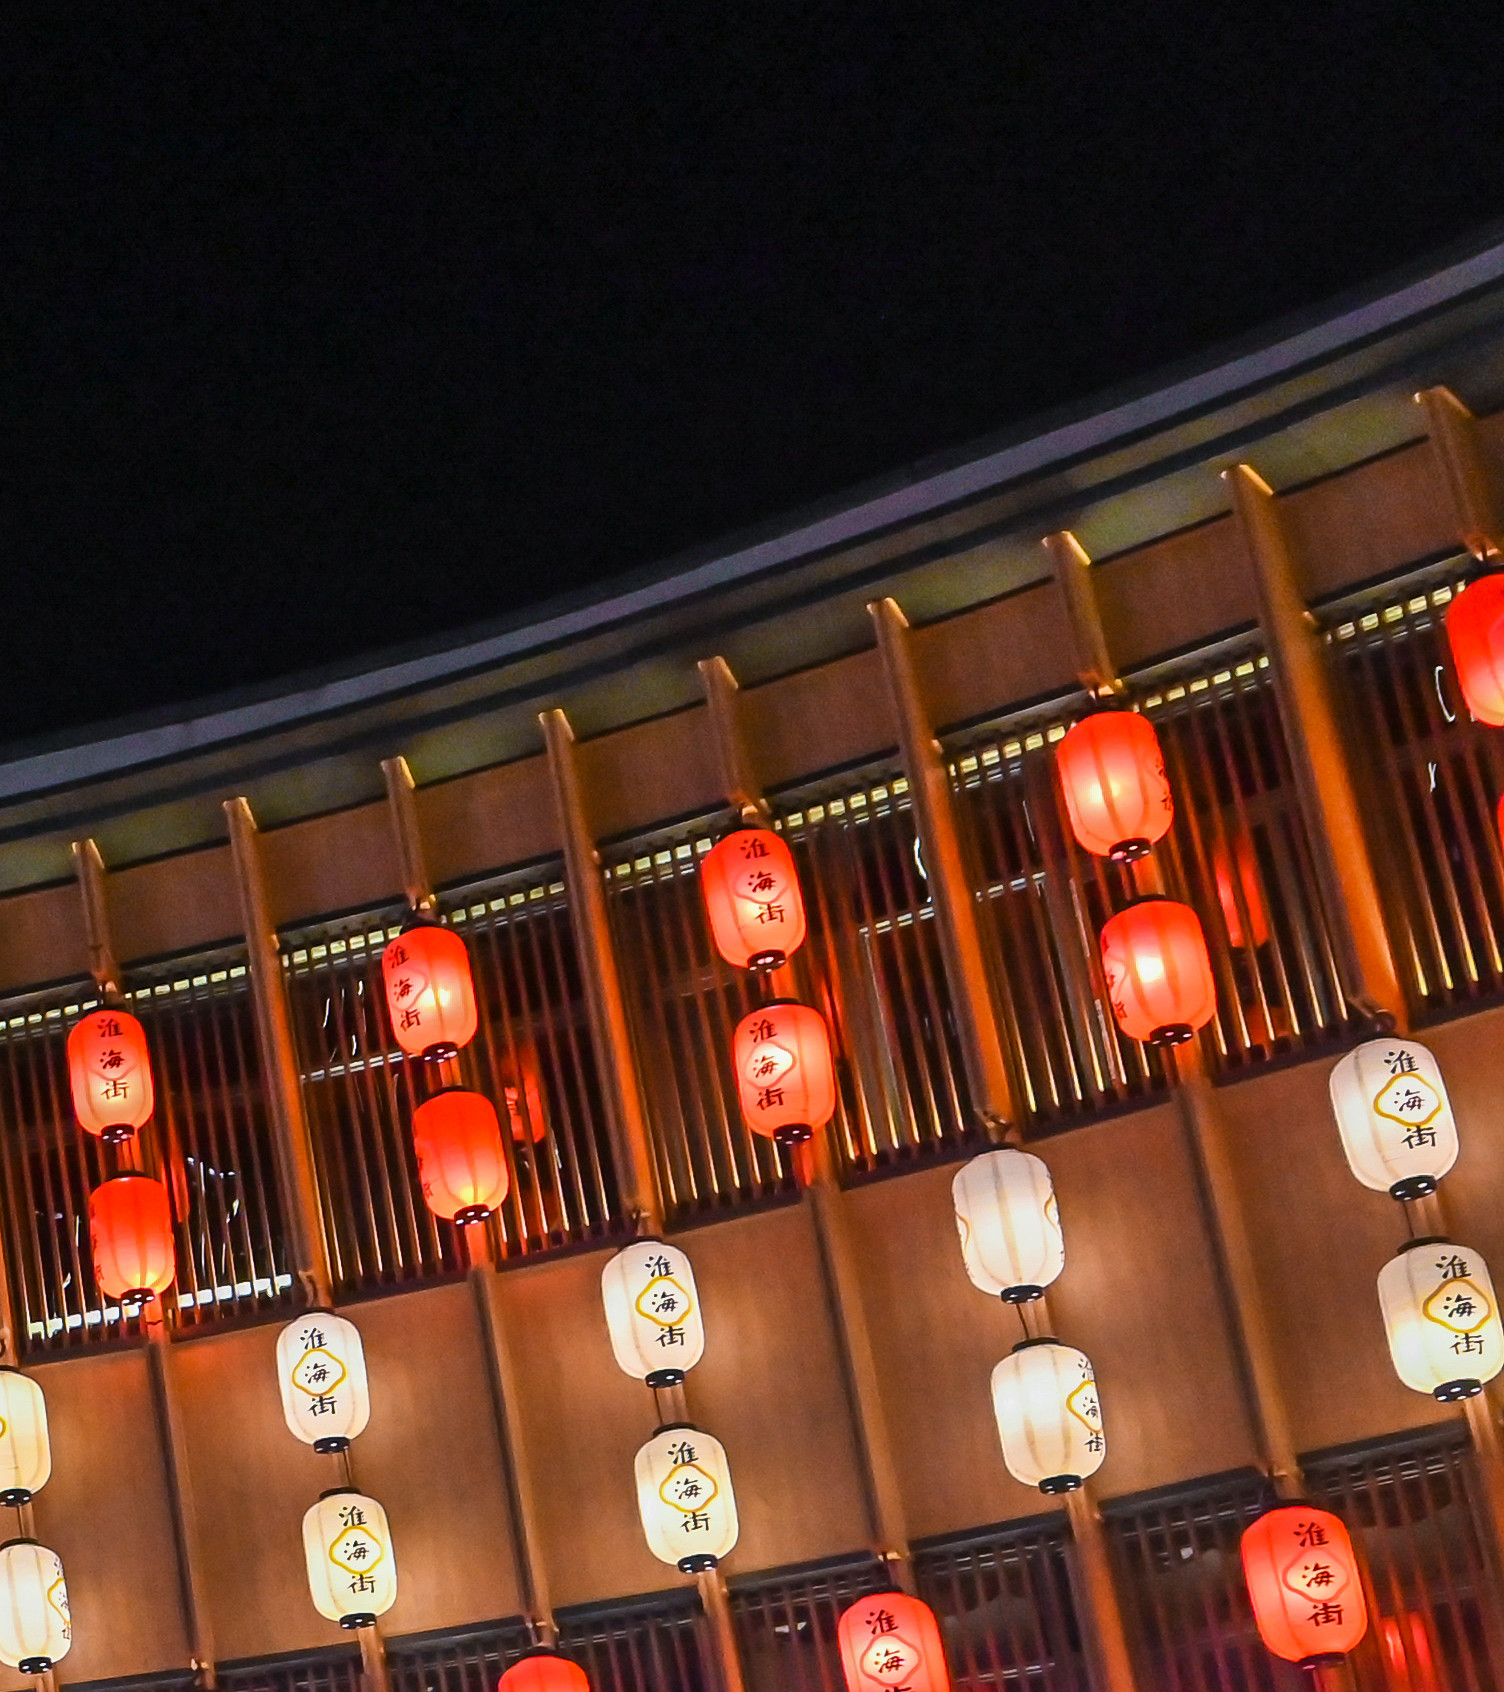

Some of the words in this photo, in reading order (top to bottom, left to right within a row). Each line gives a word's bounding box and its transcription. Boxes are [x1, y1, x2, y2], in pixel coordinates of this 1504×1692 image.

[740, 838, 786, 923] 淮海街
[385, 945, 422, 1030] 淮海街
[97, 1017, 128, 1101] 淮海街
[98, 1017, 130, 1099] 淮海街
[749, 1019, 786, 1109] 淮海街
[1383, 1049, 1437, 1149] 淮海街
[644, 1253, 686, 1348] 淮海街
[1436, 1255, 1484, 1356] 淮海街
[299, 1327, 337, 1417] 淮海街
[667, 1441, 711, 1533] 淮海街
[337, 1505, 376, 1594] 淮海街
[1292, 1520, 1344, 1627] 淮海街
